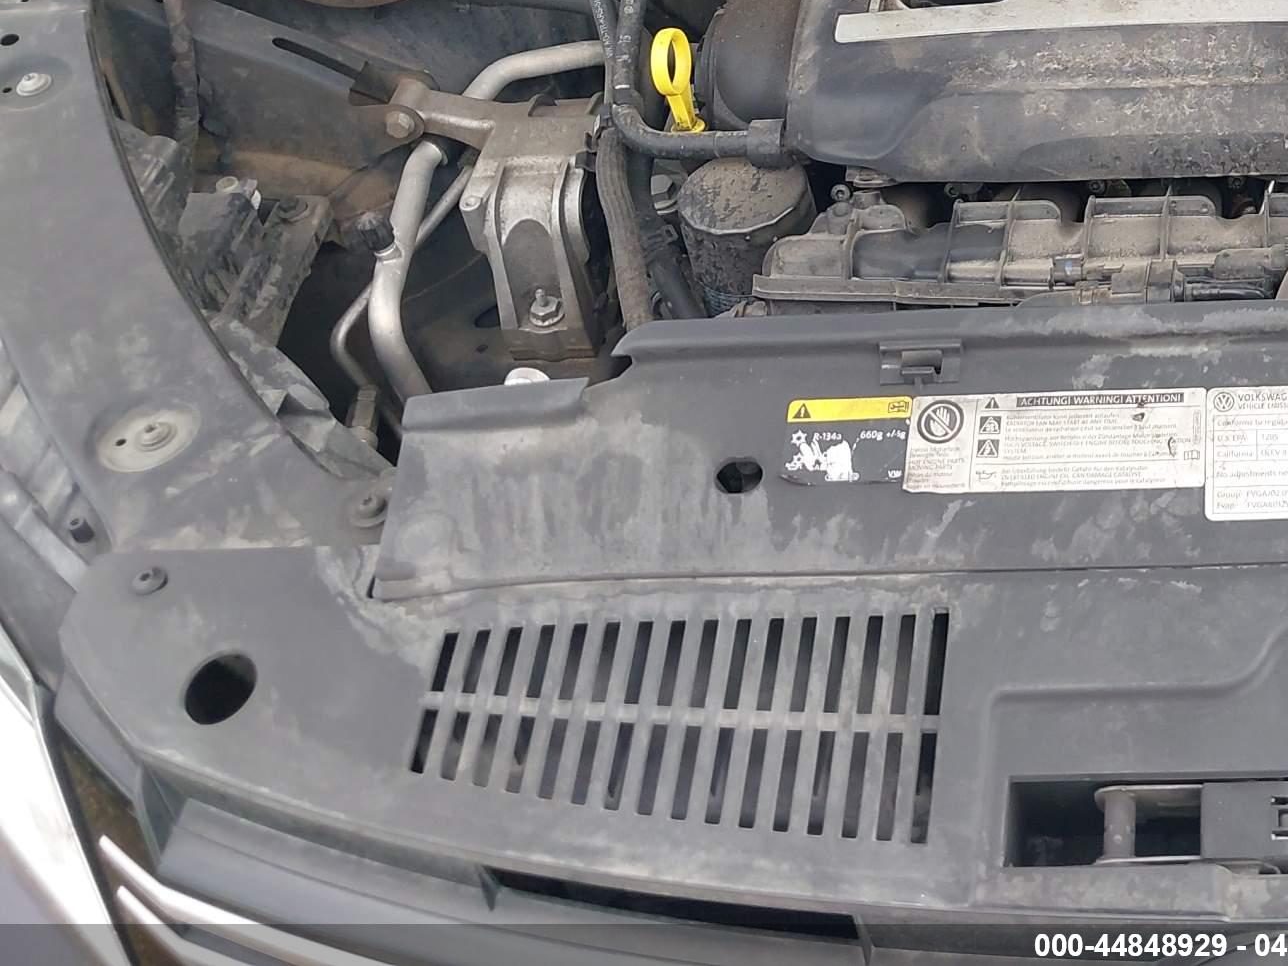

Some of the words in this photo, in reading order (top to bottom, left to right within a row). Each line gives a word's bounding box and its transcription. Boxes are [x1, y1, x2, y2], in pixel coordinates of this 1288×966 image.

[1238, 402, 1264, 410] VEHICLE
[813, 431, 843, 440] R-134a
[859, 430, 883, 441] 660g
